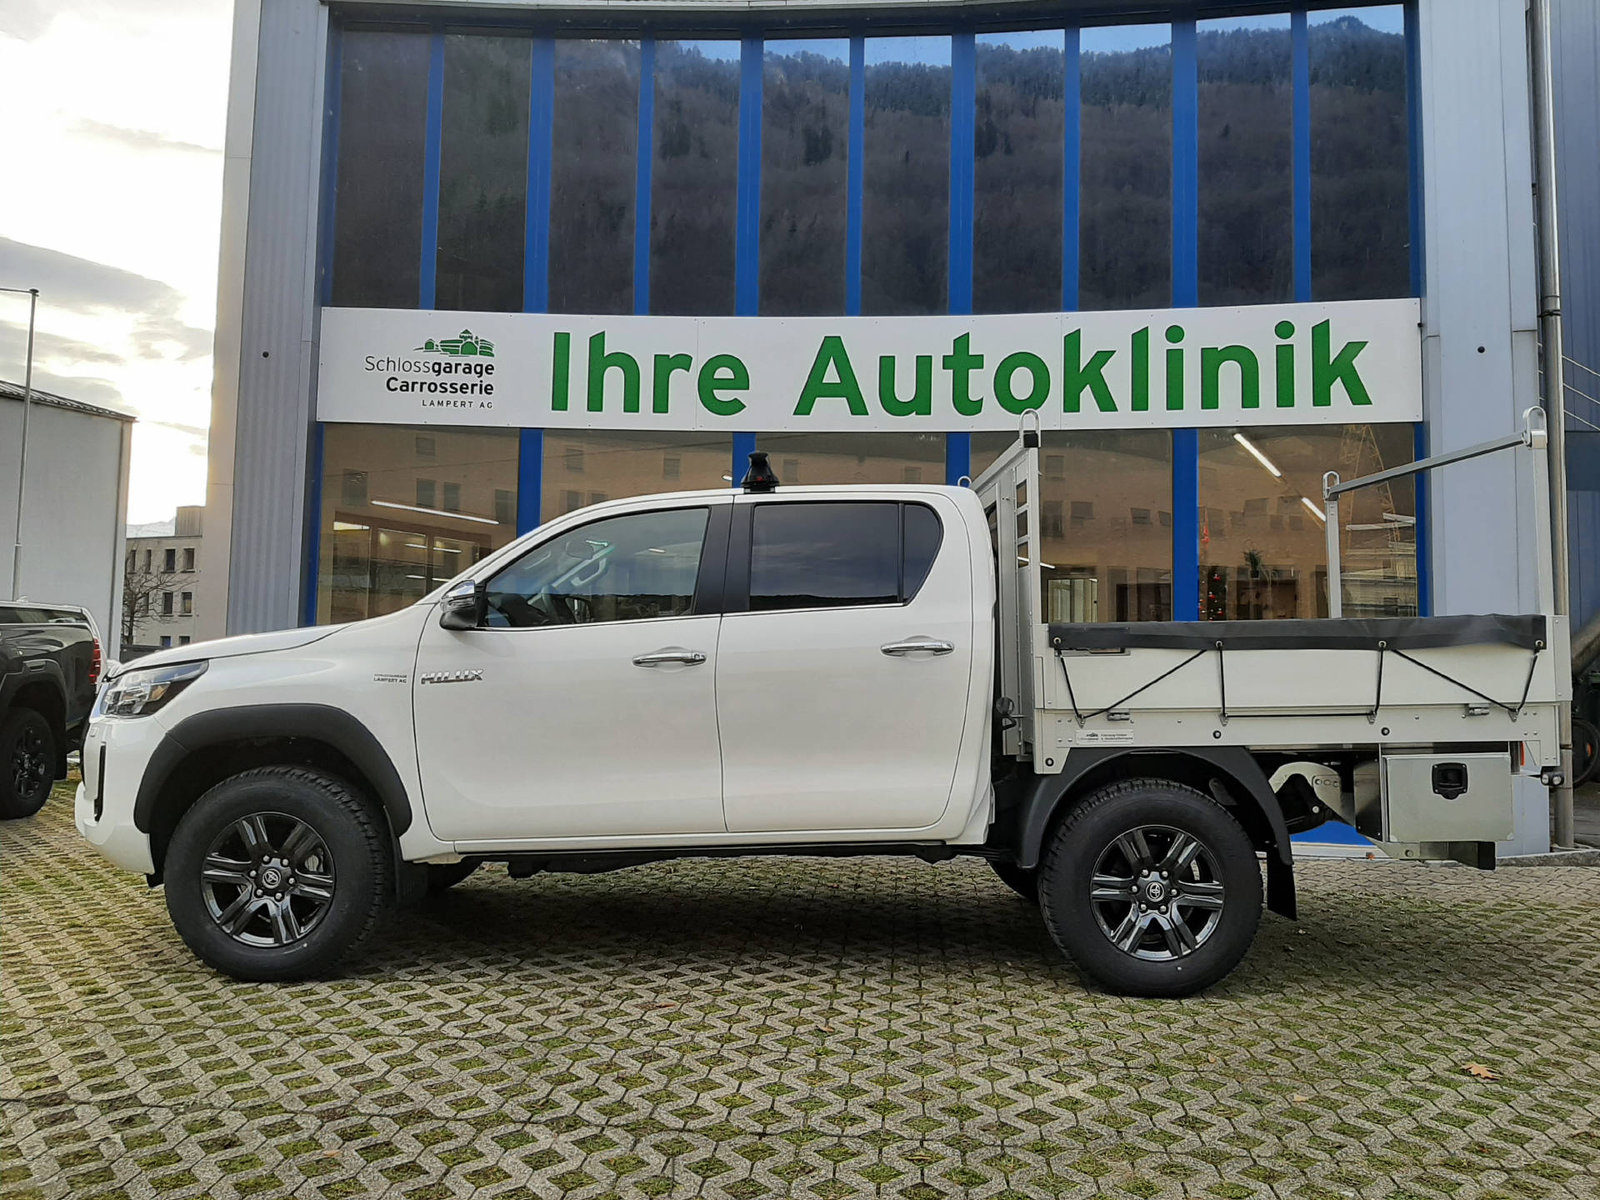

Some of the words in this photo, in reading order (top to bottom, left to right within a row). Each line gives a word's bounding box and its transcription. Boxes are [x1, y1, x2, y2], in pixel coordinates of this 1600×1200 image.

[364, 355, 495, 378] Schlossgarage
[551, 331, 750, 416] Ihre
[792, 318, 1373, 417] Autoklinik
[386, 376, 494, 395] Carrosserie
[422, 399, 474, 408] LAMPERT
[479, 401, 493, 409] AG
[421, 669, 484, 685] HILUX
